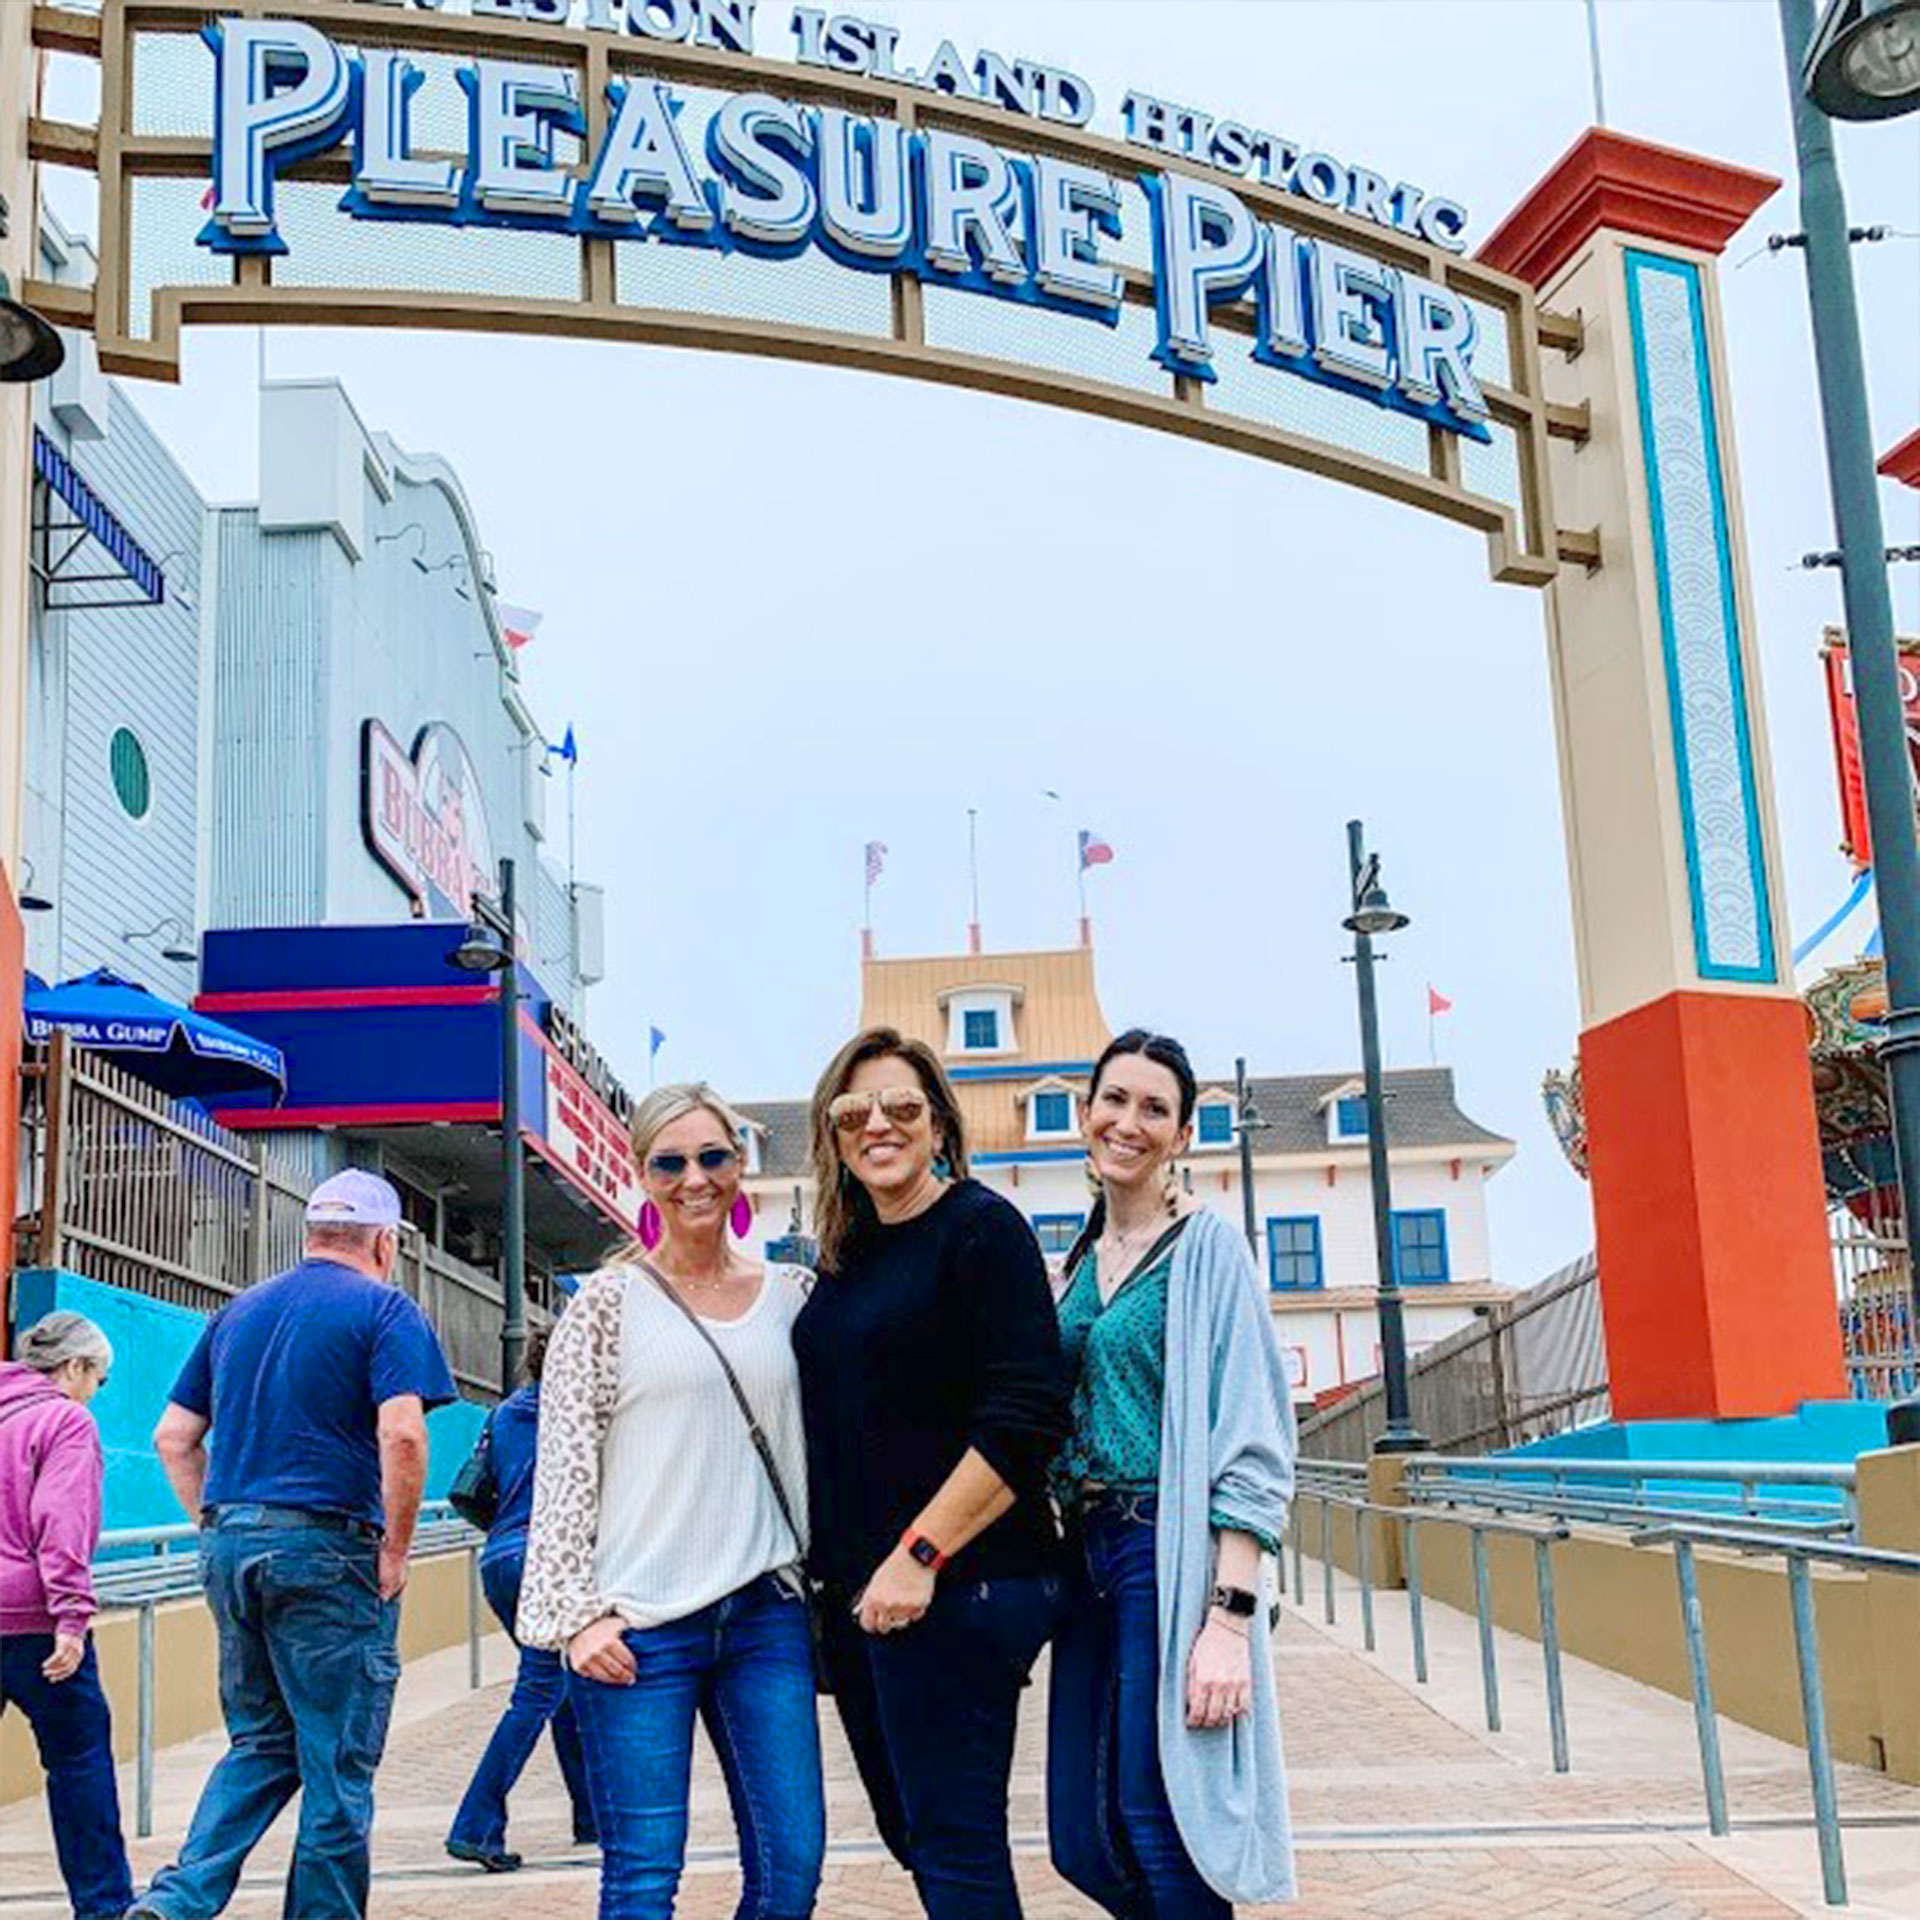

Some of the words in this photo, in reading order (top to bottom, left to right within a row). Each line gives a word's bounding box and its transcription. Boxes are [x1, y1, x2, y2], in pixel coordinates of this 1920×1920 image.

[201, 16, 1123, 322] PLEASURE
[1144, 170, 1490, 438] PIER
[791, 6, 1095, 128] ISLAND
[1121, 90, 1468, 252] HISTORIC
[106, 1022, 167, 1042] GUMP
